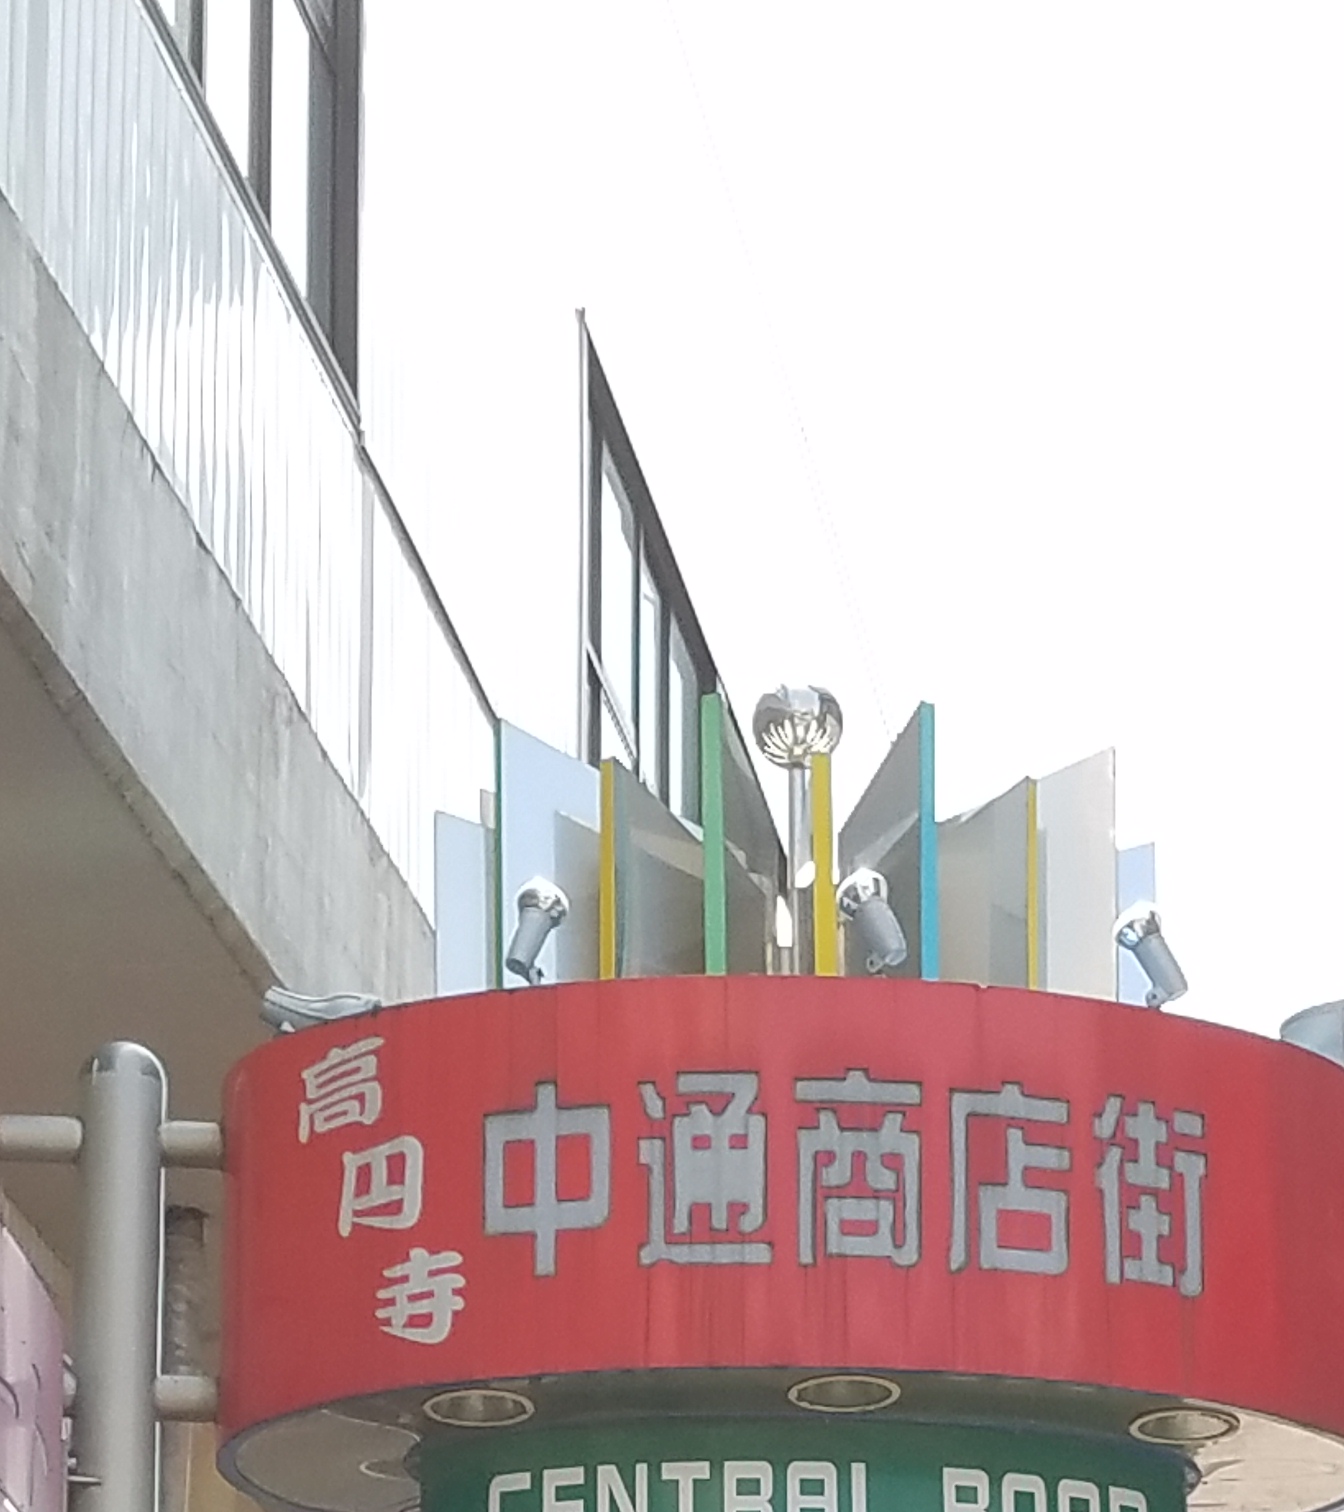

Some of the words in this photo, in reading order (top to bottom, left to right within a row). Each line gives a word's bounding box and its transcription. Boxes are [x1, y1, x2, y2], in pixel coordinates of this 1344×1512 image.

[297, 1036, 465, 1344] 高円寺
[483, 1067, 1207, 1297] 中通商店街
